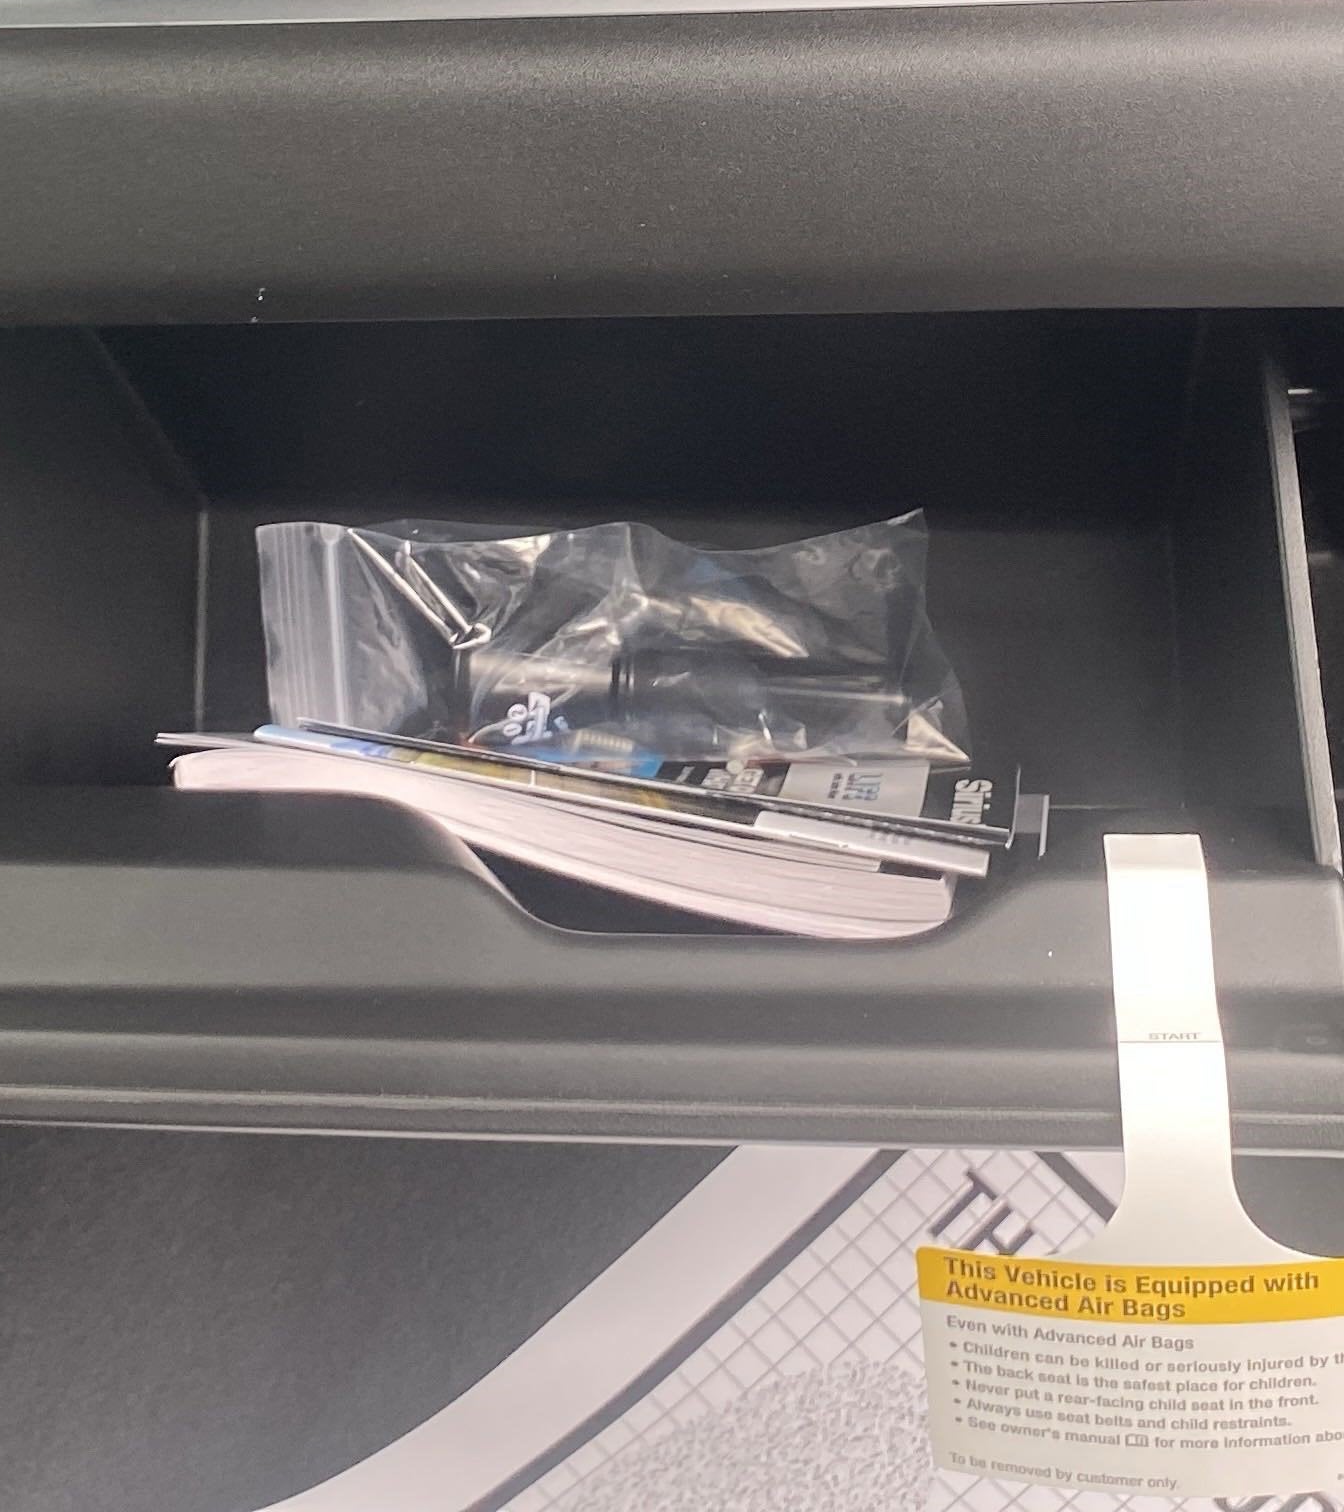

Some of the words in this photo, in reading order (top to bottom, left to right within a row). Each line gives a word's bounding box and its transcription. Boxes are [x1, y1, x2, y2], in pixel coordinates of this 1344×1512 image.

[1149, 1032, 1202, 1040] START
[943, 1256, 996, 1281] This
[1005, 1264, 1096, 1292] Vehicle
[1105, 1274, 1126, 1293] is
[1135, 1274, 1254, 1298] Equipped
[1263, 1271, 1319, 1293] with
[946, 1280, 1068, 1312] Advanced
[1077, 1296, 1114, 1315] Air
[1122, 1298, 1185, 1321] Bags
[946, 1314, 987, 1334] Even
[992, 1322, 1028, 1339] with
[1033, 1327, 1117, 1347] Advanced
[1122, 1335, 1146, 1349] Air
[1151, 1336, 1194, 1352] Bags
[962, 1340, 1030, 1362] Children
[1035, 1352, 1064, 1365] can
[1070, 1354, 1089, 1368] be
[1094, 1356, 1140, 1371] killed
[1145, 1360, 1162, 1372] or
[1167, 1360, 1241, 1374] seriously
[1247, 1356, 1304, 1373] injured
[1309, 1355, 1329, 1369] by
[963, 1360, 993, 1376] The
[997, 1364, 1034, 1381] back
[1038, 1372, 1071, 1385] seat
[1076, 1374, 1089, 1388] is
[1093, 1376, 1118, 1389] the
[1123, 1378, 1171, 1392] safest
[1176, 1379, 1218, 1394] place
[1223, 1379, 1244, 1392] for
[1249, 1374, 1317, 1390] children.
[965, 1378, 1009, 1396] Never
[1015, 1384, 1040, 1400] put
[1044, 1392, 1054, 1402] a
[1058, 1393, 1144, 1411] rear-facing
[1149, 1397, 1187, 1411] child
[1191, 1399, 1225, 1412] seat
[1230, 1398, 1244, 1411] in
[1249, 1397, 1273, 1410] the
[1278, 1394, 1319, 1409] front.
[966, 1397, 1022, 1418] Always
[1025, 1407, 1052, 1420] use
[1057, 1411, 1090, 1425] seat
[1094, 1413, 1133, 1428] belts
[1137, 1416, 1166, 1430] and
[1170, 1417, 1209, 1430] child
[1212, 1415, 1292, 1430] restraints.
[967, 1416, 996, 1432] See
[1000, 1422, 1060, 1440] owner's
[1065, 1429, 1121, 1446] manual
[1154, 1436, 1175, 1449] for
[1180, 1437, 1219, 1449] more
[1224, 1433, 1311, 1448] information
[948, 1451, 966, 1465] To
[969, 1454, 987, 1469] be
[991, 1459, 1052, 1479] removed
[1056, 1468, 1073, 1482] by
[1076, 1470, 1144, 1488] customer
